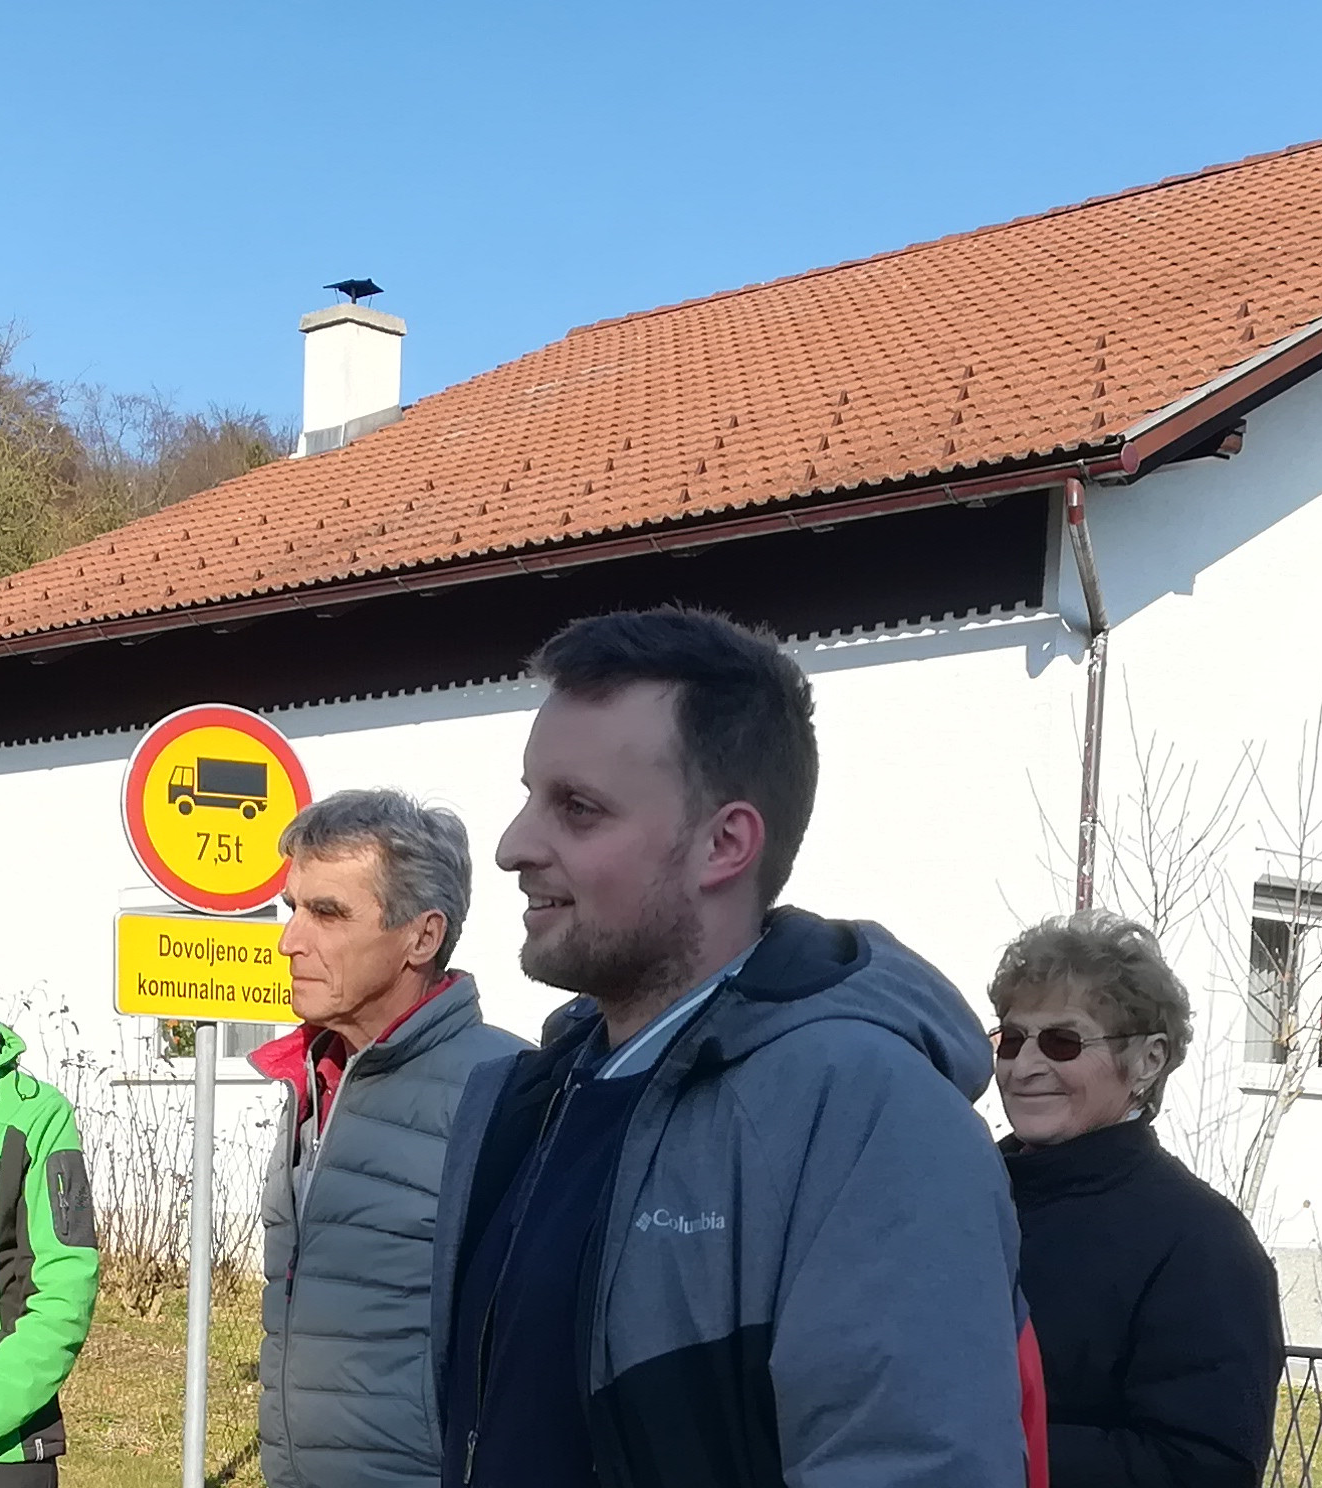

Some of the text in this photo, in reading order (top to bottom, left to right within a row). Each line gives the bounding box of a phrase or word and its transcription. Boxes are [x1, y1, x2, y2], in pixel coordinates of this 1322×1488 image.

[159, 933, 272, 967] Dovoljeno za
[138, 972, 292, 1006] komunalna vozila
